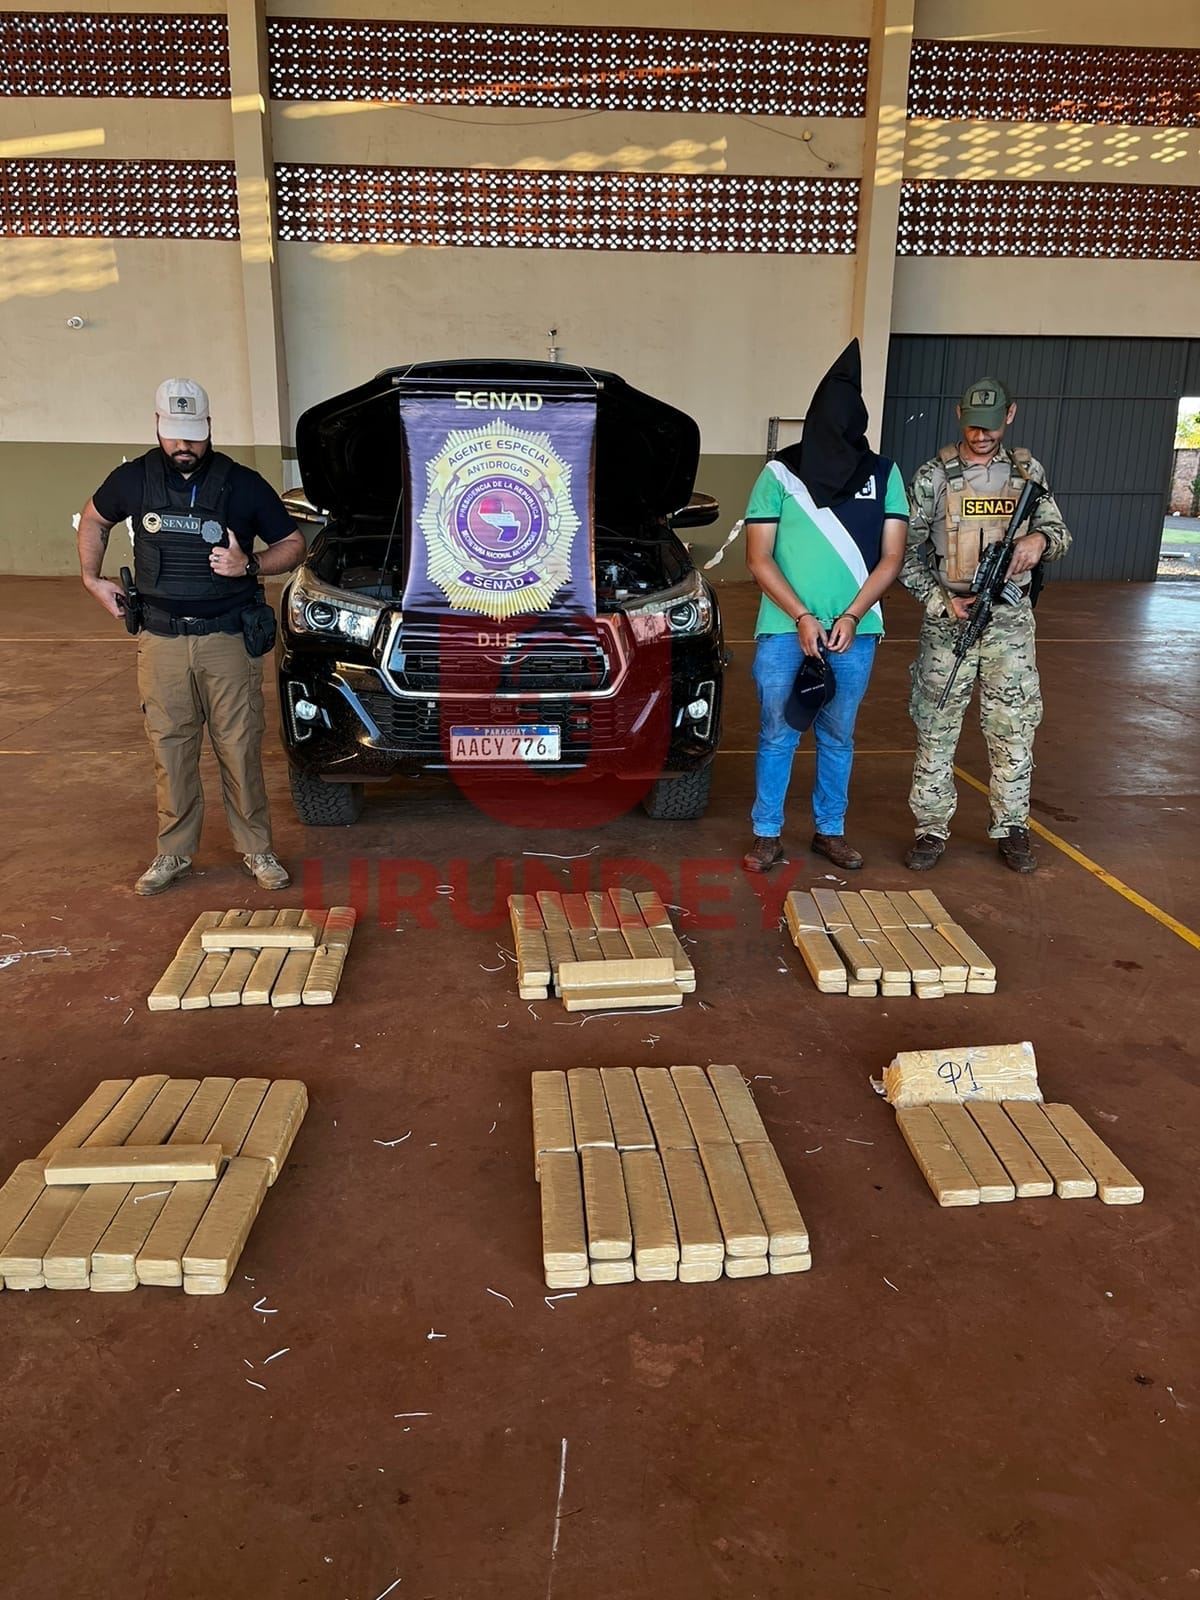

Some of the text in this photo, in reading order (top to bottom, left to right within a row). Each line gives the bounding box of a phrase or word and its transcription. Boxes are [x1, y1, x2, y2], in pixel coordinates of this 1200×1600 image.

[455, 391, 543, 411] SENAD
[448, 439, 550, 468] AGENTE ESPECIAL
[467, 460, 530, 477] ANTIDROGAS
[966, 500, 1015, 514] SENAD
[162, 520, 198, 530] SENAD
[473, 575, 525, 590] SENAD
[484, 727, 527, 736] PARAGUAY
[456, 737, 547, 756] AACY 776
